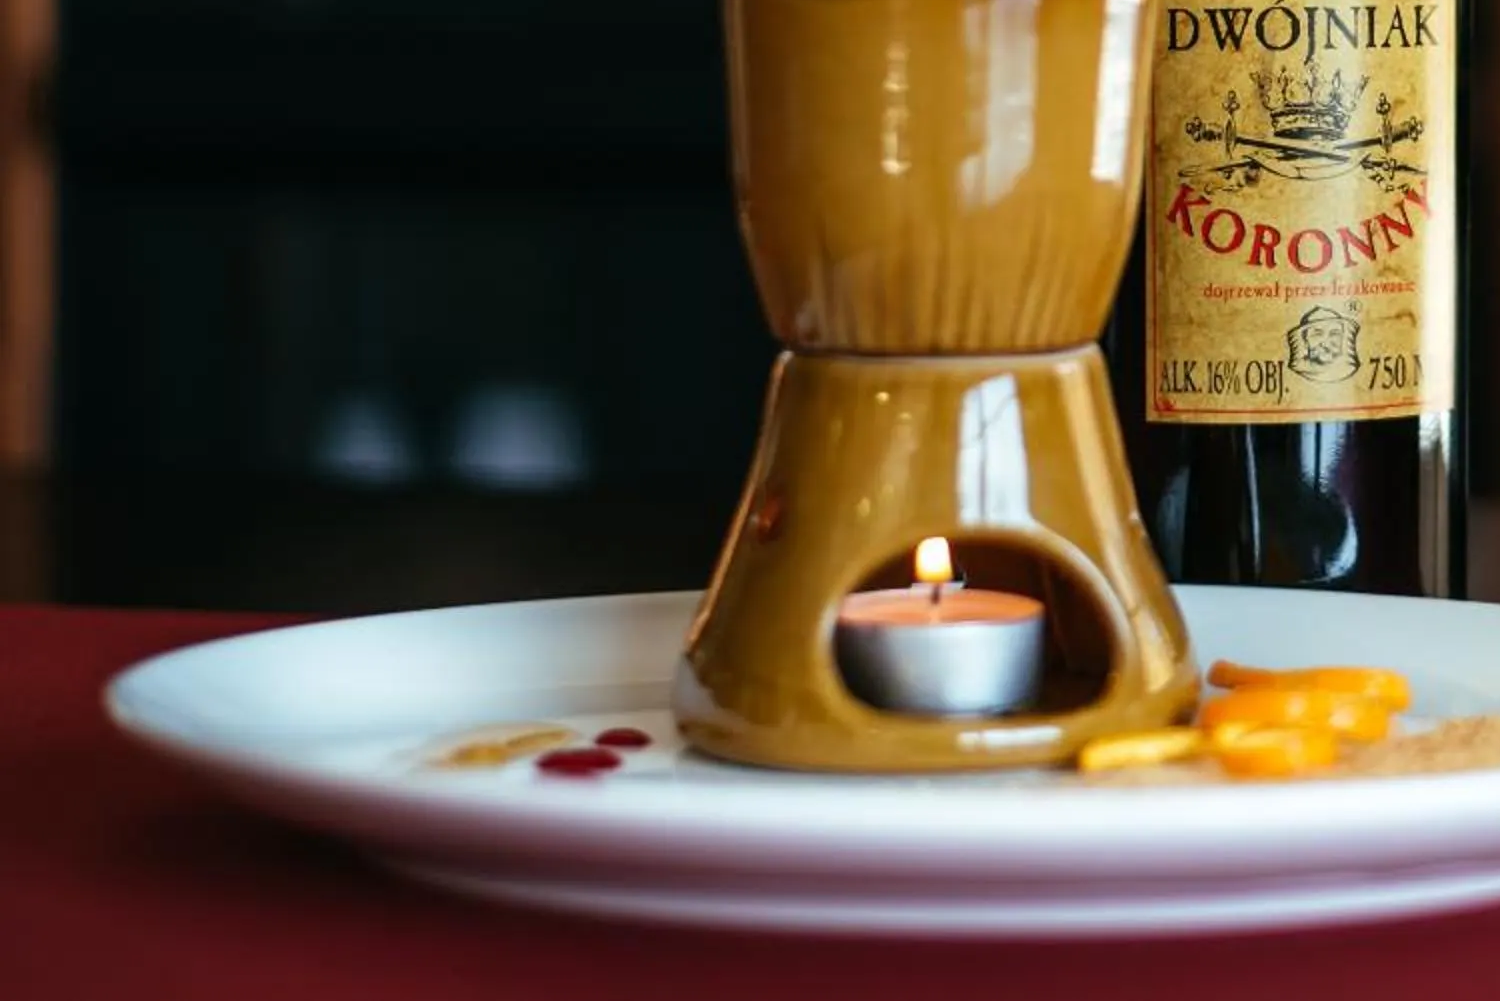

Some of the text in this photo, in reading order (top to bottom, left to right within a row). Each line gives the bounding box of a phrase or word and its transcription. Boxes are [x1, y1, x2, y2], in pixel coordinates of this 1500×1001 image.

[1160, 360, 1290, 406] ALK. 16% OBJ.
[1368, 353, 1406, 391] 750
